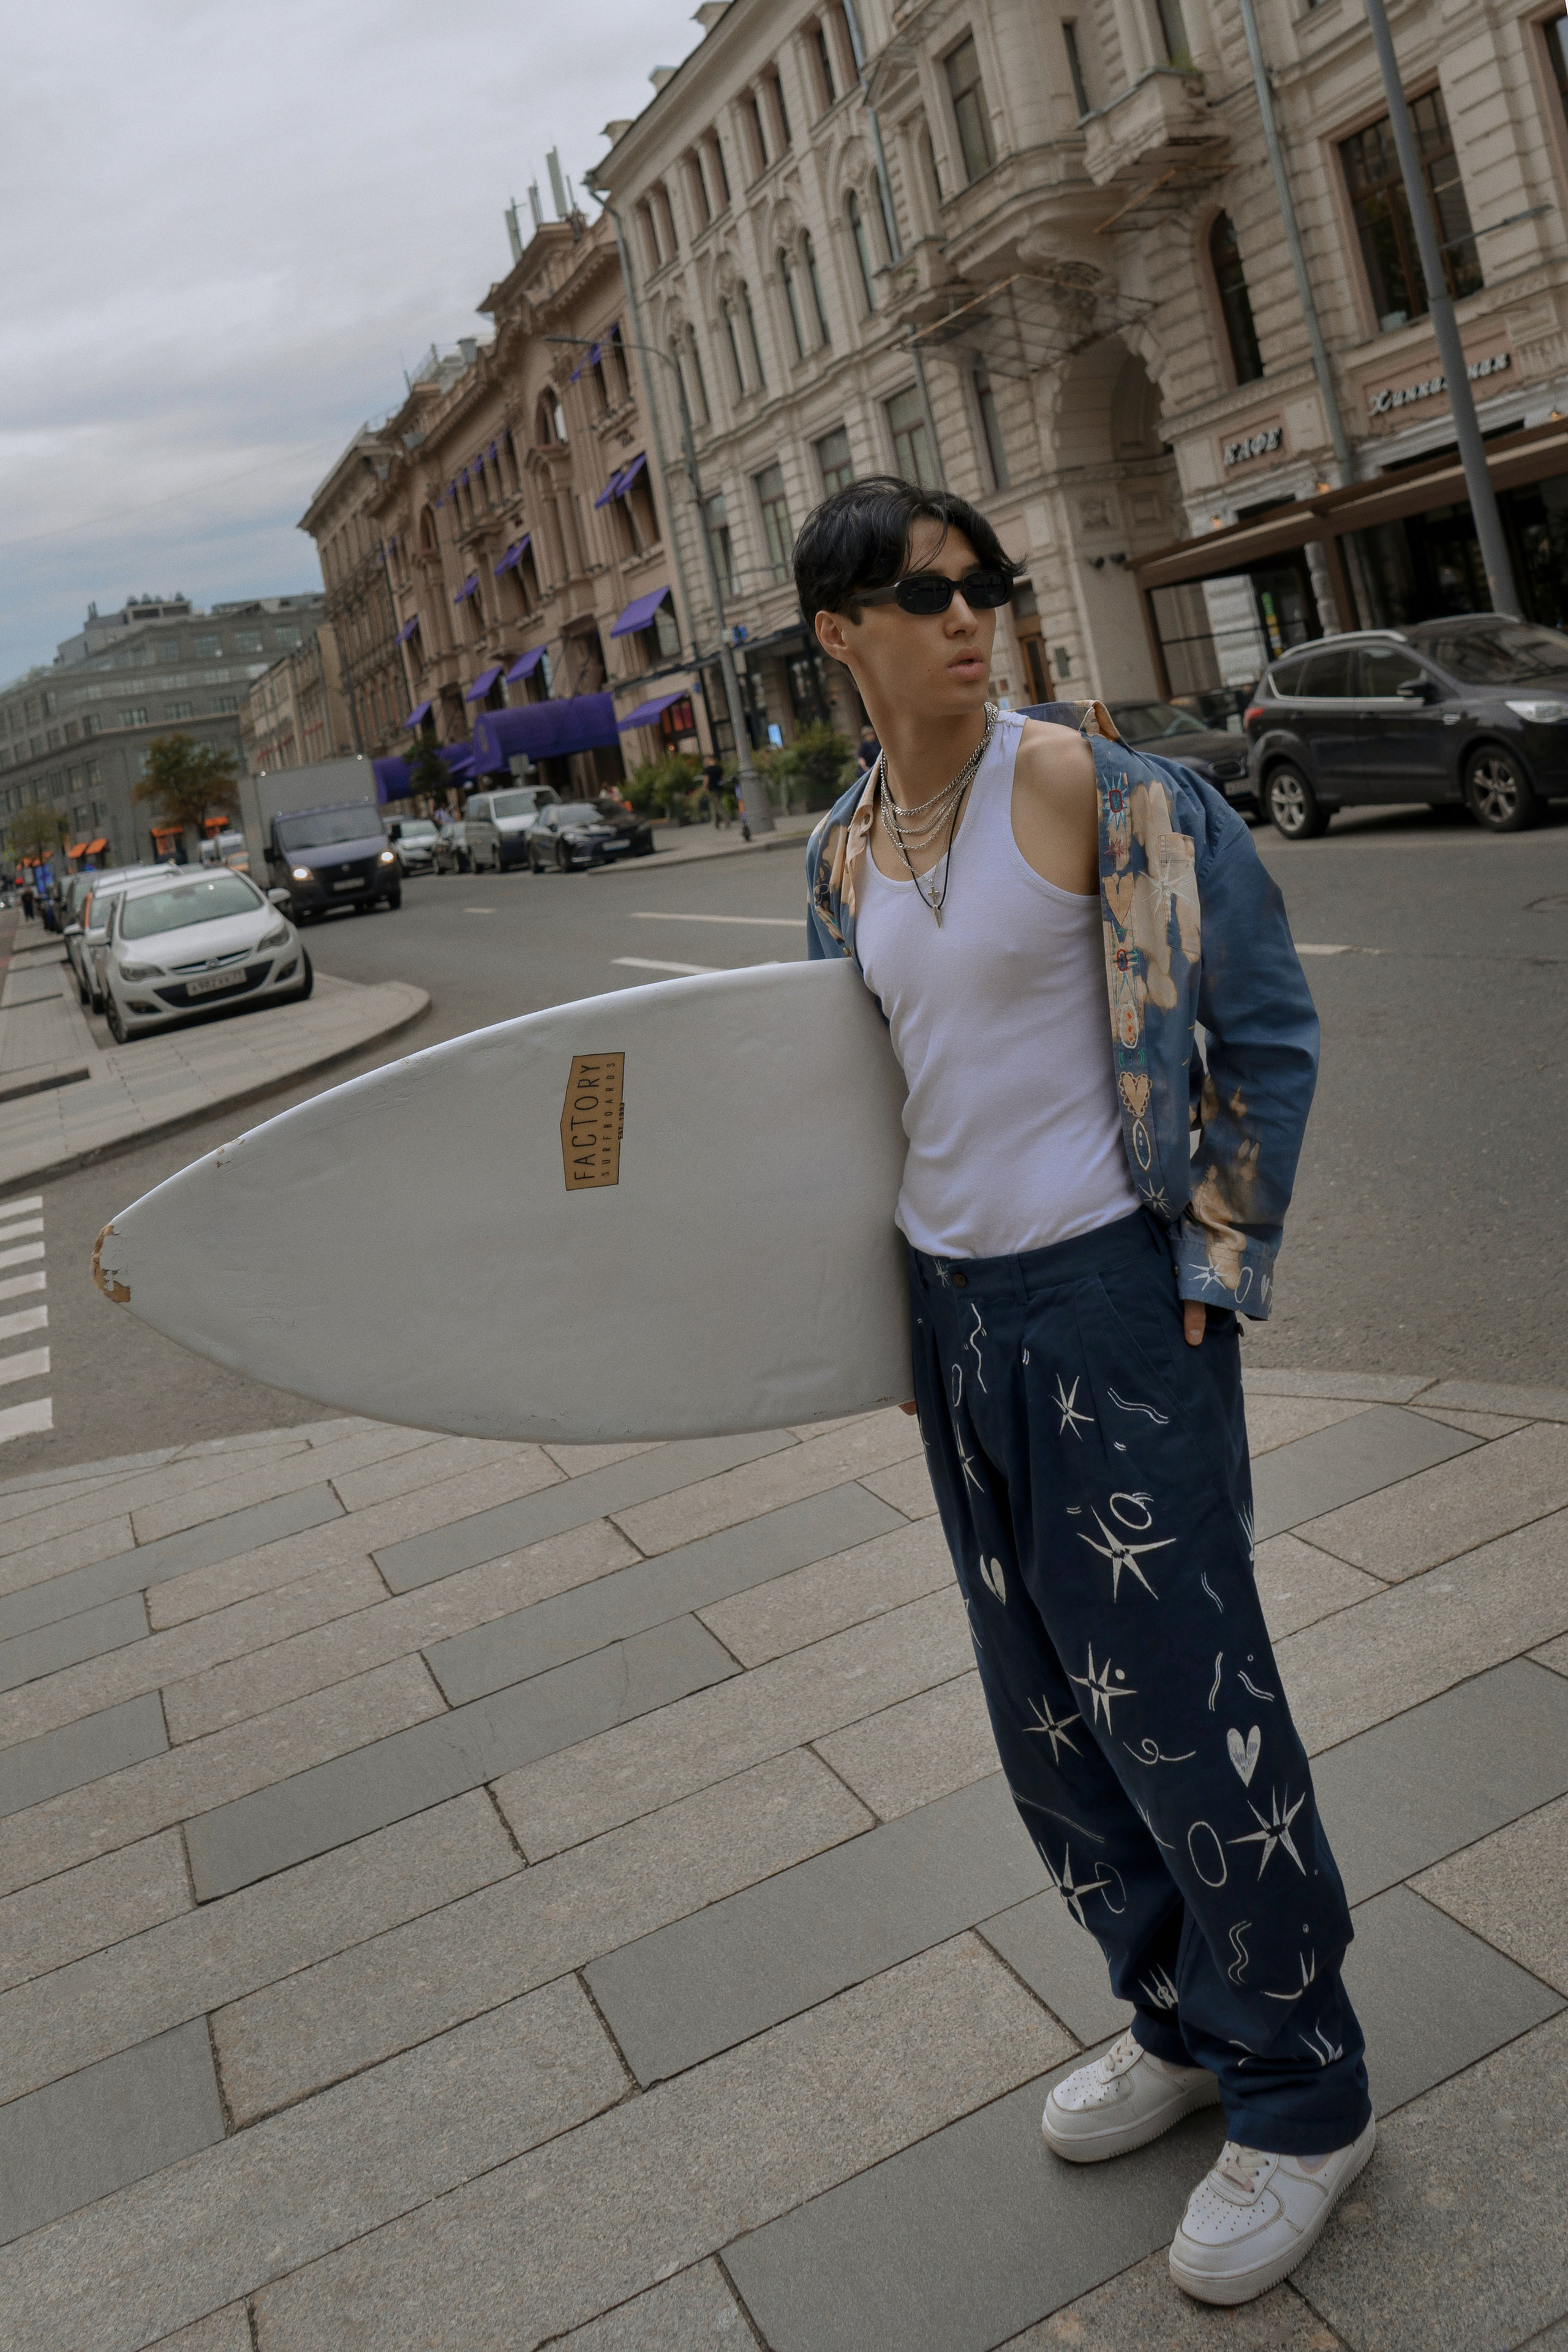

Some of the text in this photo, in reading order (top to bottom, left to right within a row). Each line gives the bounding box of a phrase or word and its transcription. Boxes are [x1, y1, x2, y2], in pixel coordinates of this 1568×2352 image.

[1368, 353, 1509, 417] Хинканая
[571, 1065, 600, 1180] FACTORY
[601, 1062, 616, 1177] SURFBOARDS
